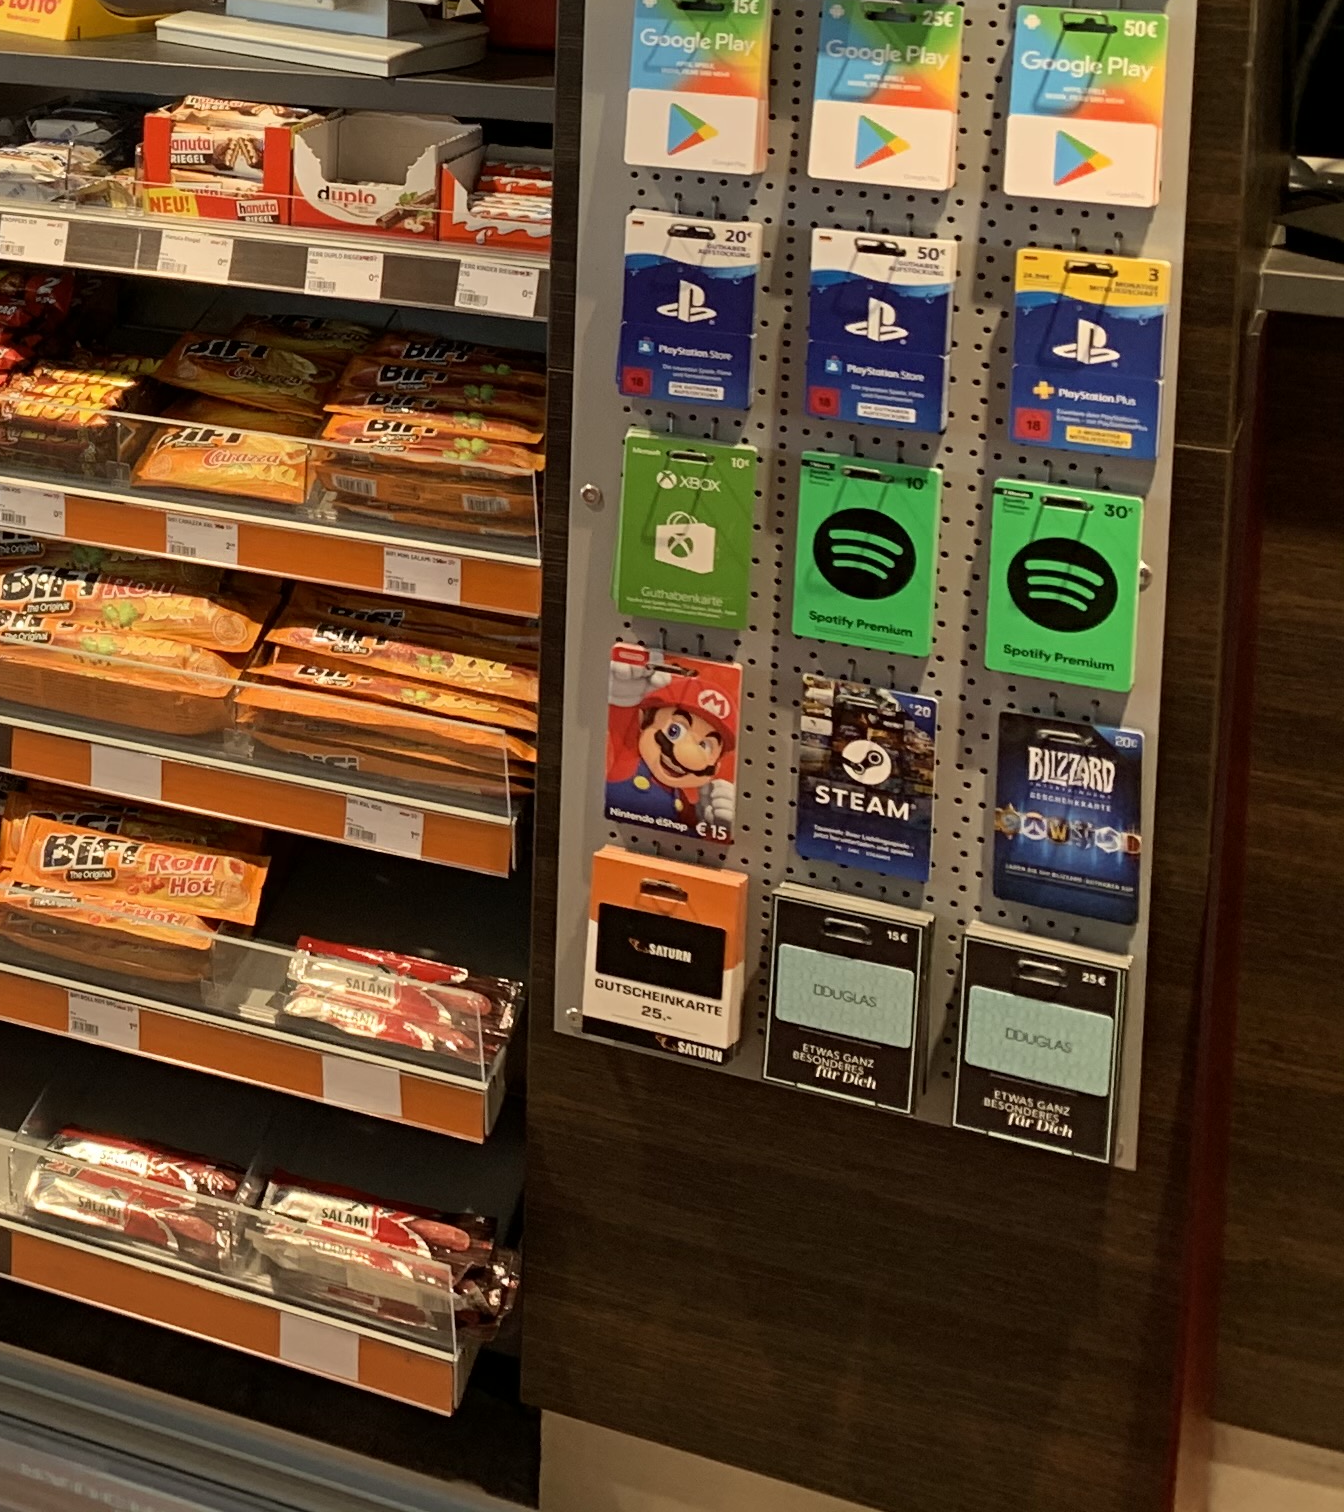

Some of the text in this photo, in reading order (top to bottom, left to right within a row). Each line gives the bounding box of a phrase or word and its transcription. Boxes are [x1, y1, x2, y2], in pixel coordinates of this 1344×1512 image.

[732, 0, 759, 16] 15€
[922, 8, 954, 28] 25€
[1123, 19, 1158, 38] 50€
[640, 28, 756, 55] Google Play
[826, 38, 949, 71] Google Play
[1021, 51, 1153, 82] Google Play
[148, 195, 192, 214] NEU!
[318, 186, 377, 206] duplo
[237, 201, 279, 216] hanuta
[202, 448, 280, 467] Carazza
[680, 475, 722, 492] XBOX
[640, 586, 723, 608] Guthabenkarte
[808, 610, 913, 638] Spotify Premium
[1003, 643, 1114, 672] Spotify Premium
[1028, 746, 1115, 793] BLIZZARD
[814, 785, 909, 820] STEAM
[610, 806, 688, 832] Nintendo eShop
[147, 853, 216, 875] Roll
[168, 876, 216, 896] Hot
[648, 943, 692, 964] SATURN
[594, 977, 723, 1018] GUTSCHEINKARTE
[677, 1039, 723, 1063] SATURN
[792, 1049, 864, 1074] BESONDERES
[803, 1042, 874, 1068] ETWAS GANZ
[815, 1065, 877, 1092] für Dich
[321, 1207, 369, 1228] SALAMI
